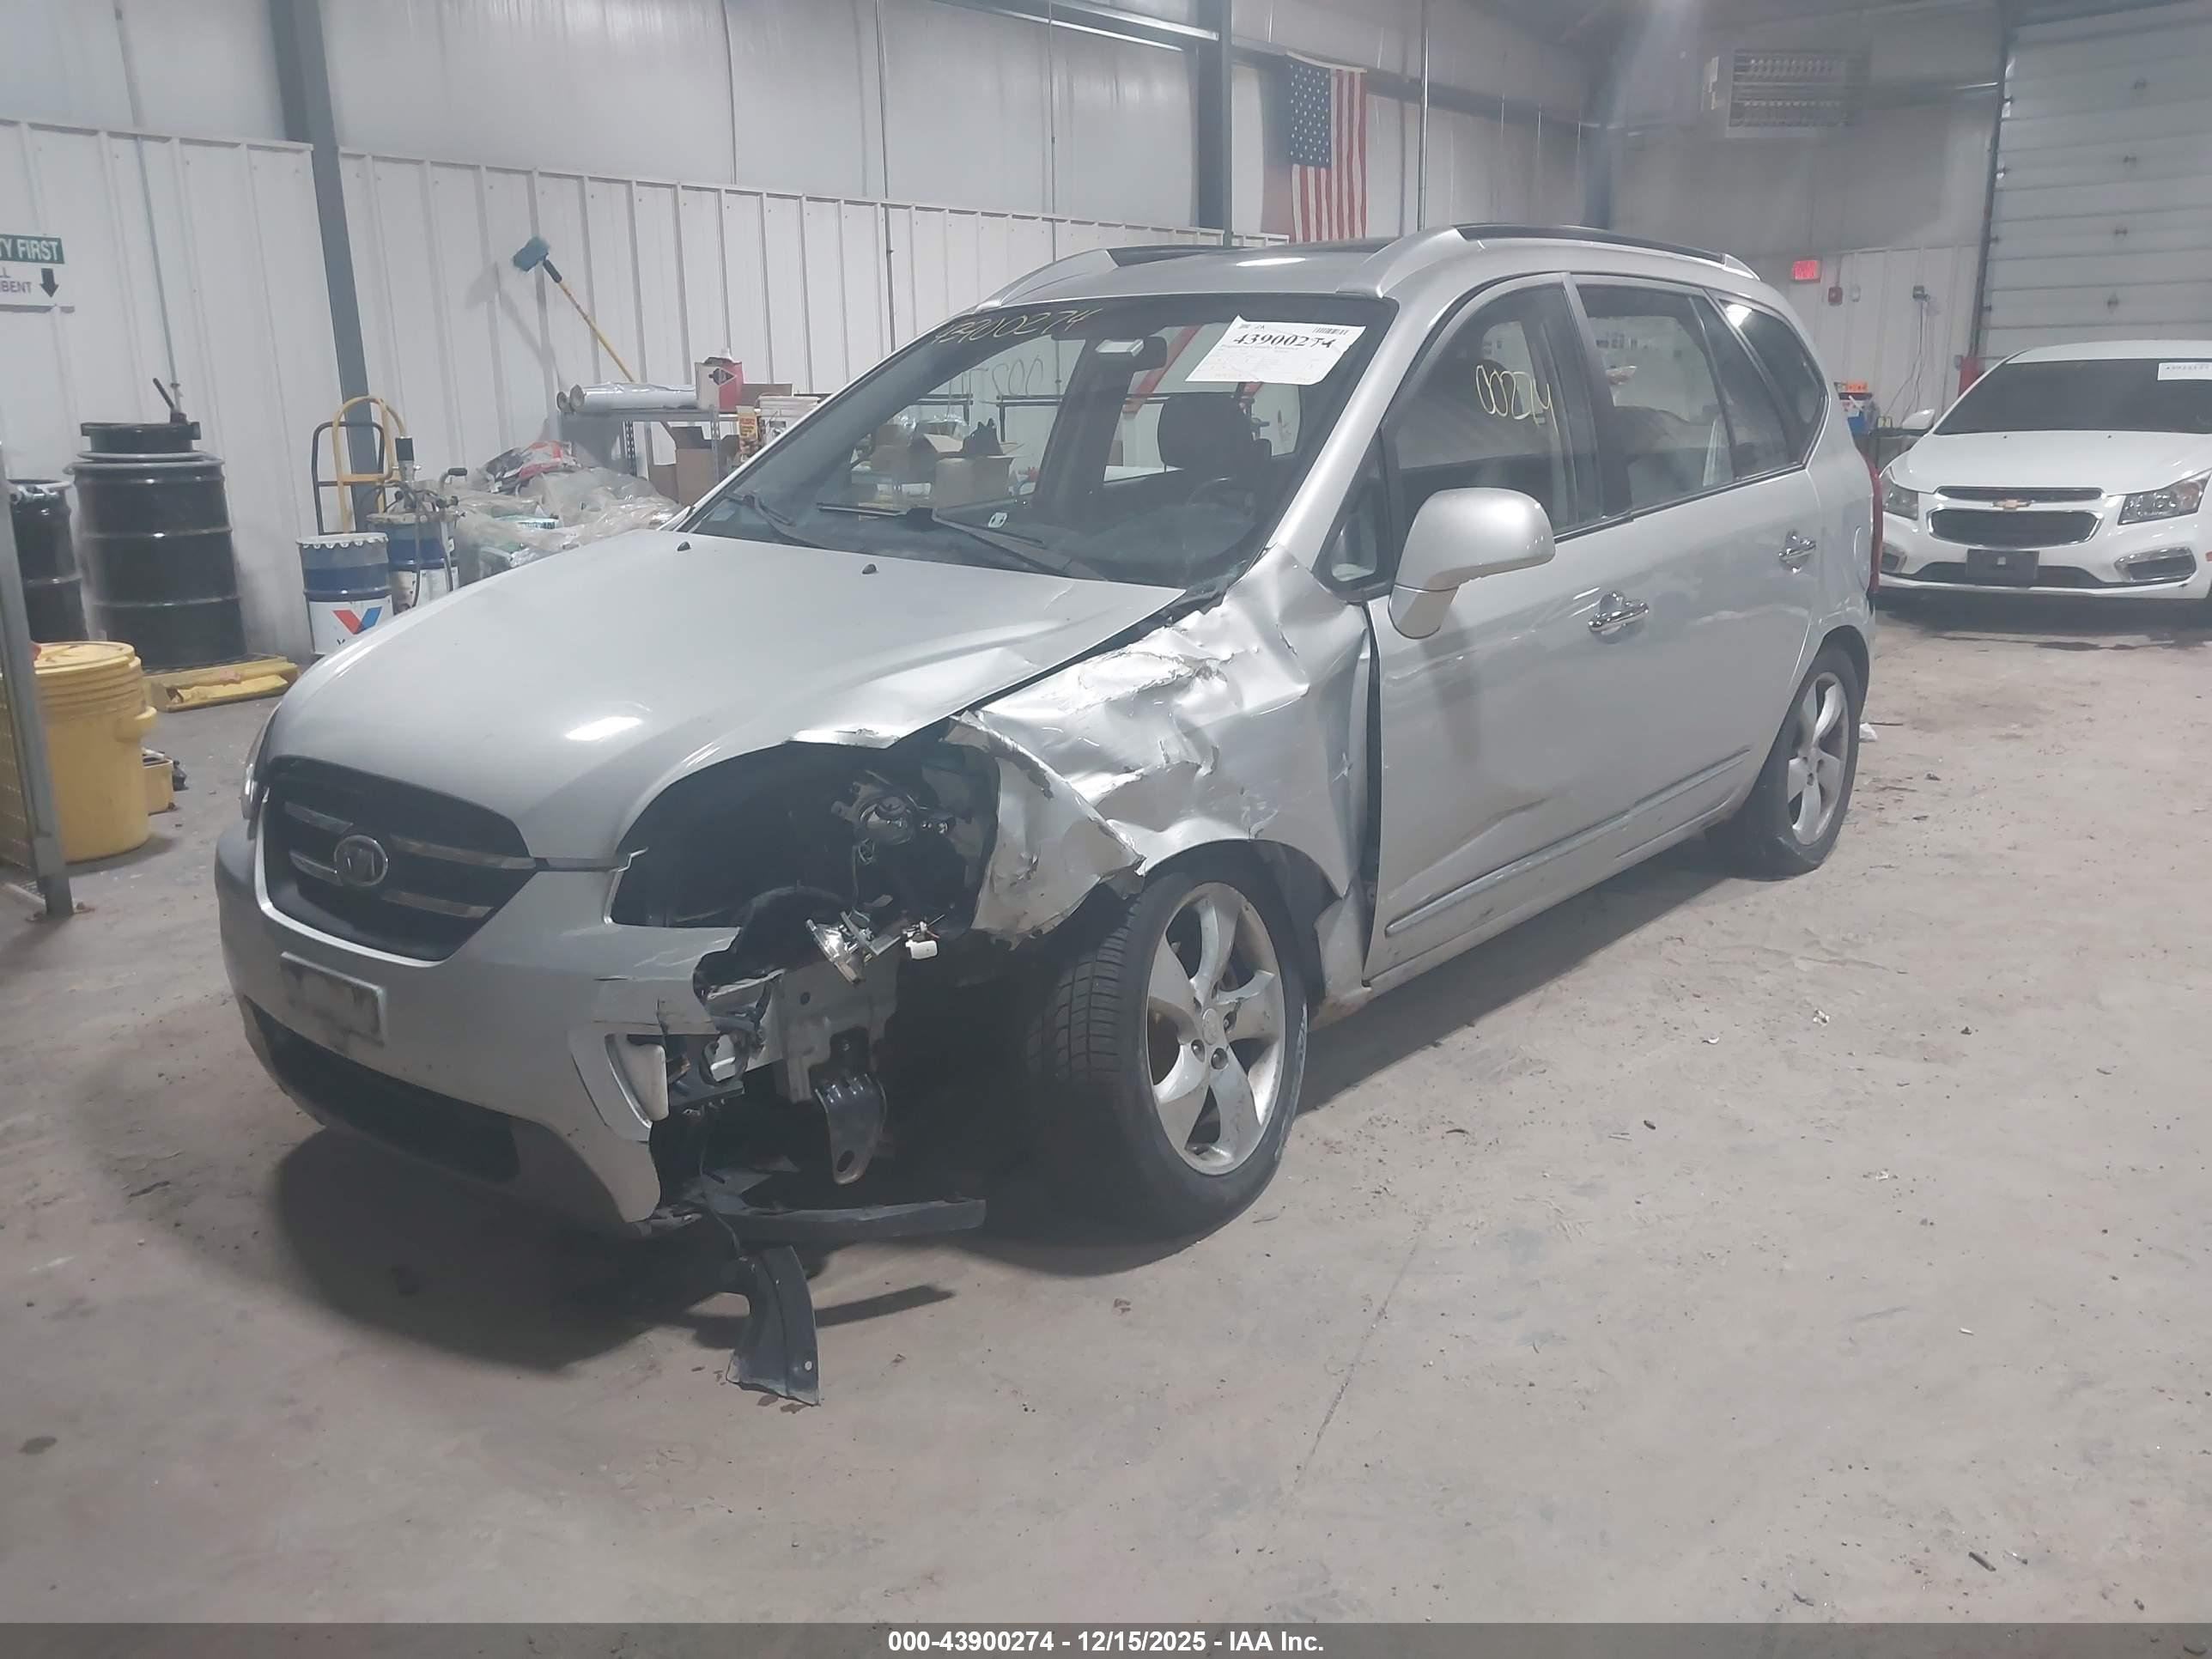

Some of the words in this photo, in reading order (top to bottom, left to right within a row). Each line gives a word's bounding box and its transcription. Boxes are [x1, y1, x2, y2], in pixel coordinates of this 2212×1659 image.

[17, 240, 58, 261] FIRST
[1234, 333, 1337, 348] 43900274
[1475, 364, 1559, 439] 00274
